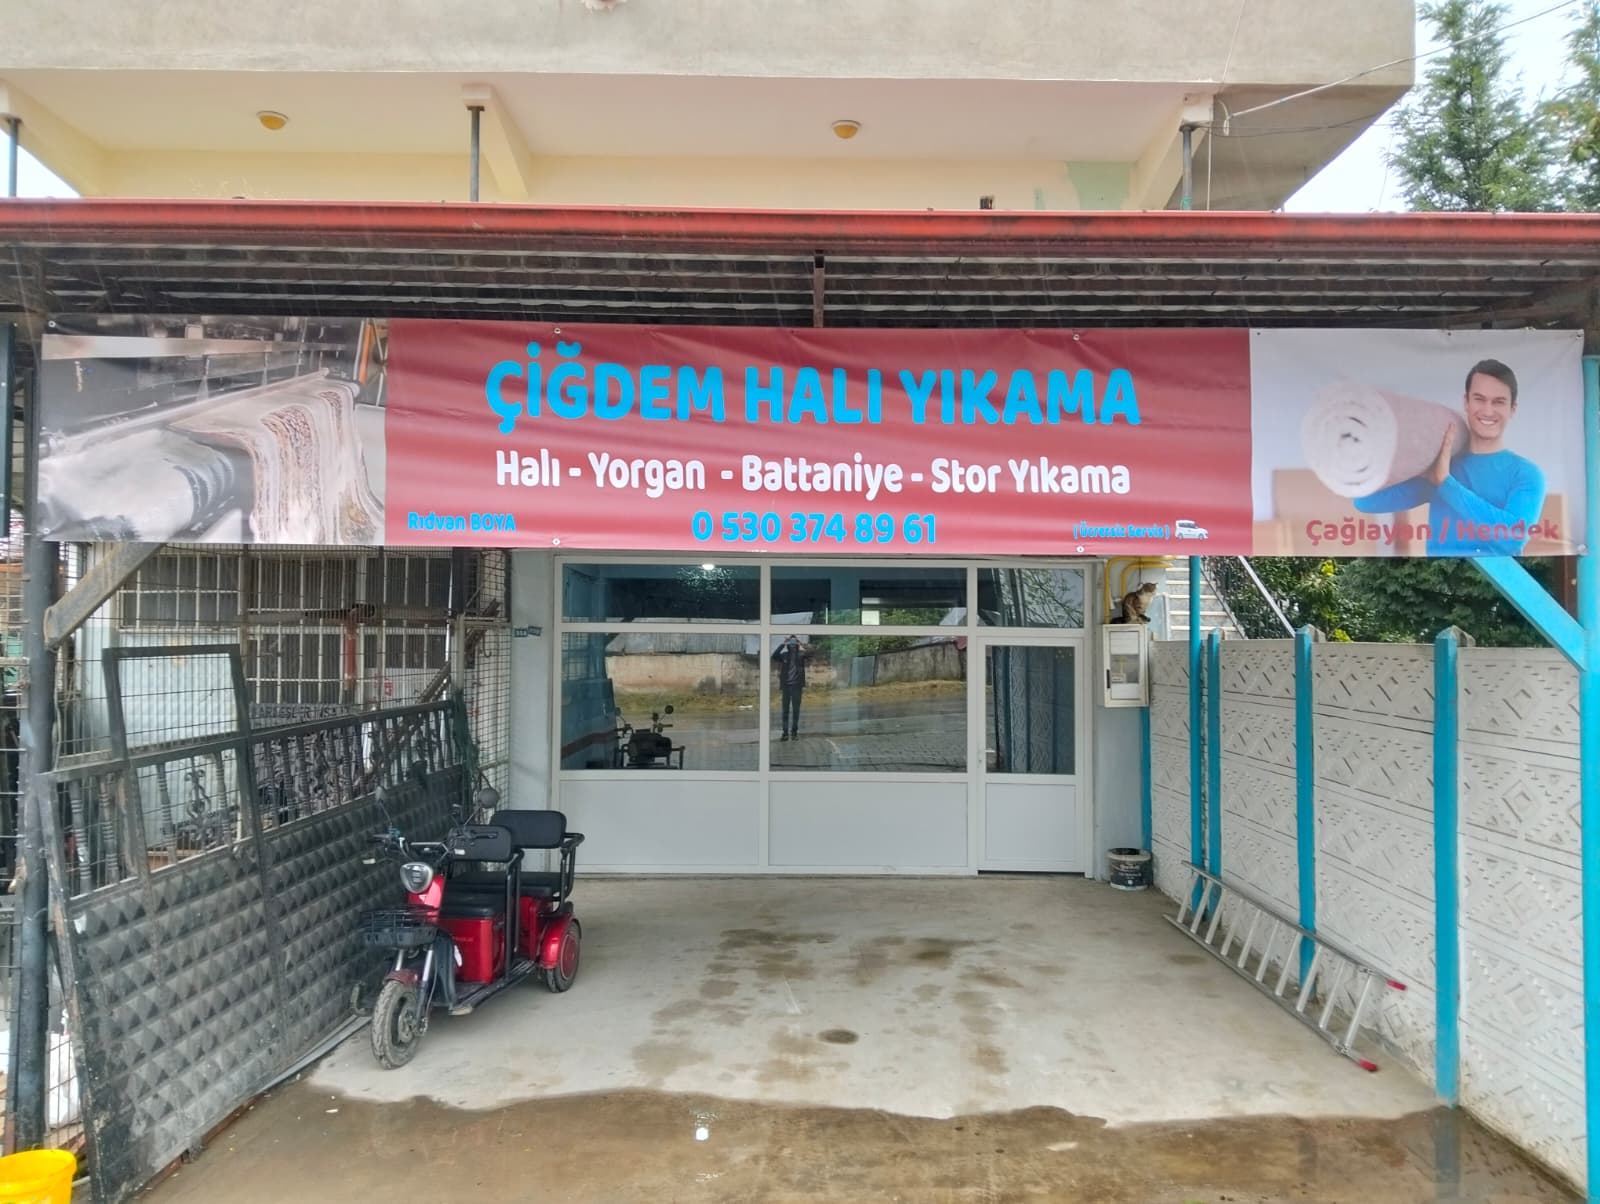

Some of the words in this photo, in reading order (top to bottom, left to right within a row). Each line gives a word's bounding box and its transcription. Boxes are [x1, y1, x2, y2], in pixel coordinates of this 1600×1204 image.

[486, 341, 726, 434] ÇİĞDEM
[744, 366, 883, 424] HALI
[898, 368, 1142, 426] YIKAMA
[496, 449, 561, 487] Halı
[568, 467, 582, 477] -
[587, 453, 706, 499] Yorgan
[720, 470, 734, 480] -
[742, 453, 904, 501] Battaniye
[910, 472, 924, 482] -
[931, 458, 1002, 493] Stor
[1007, 457, 1131, 494] Yıkama
[407, 511, 466, 532] Rıdvan
[469, 513, 517, 533] BOYA
[691, 510, 714, 542] 0
[721, 511, 783, 543] 530
[789, 511, 848, 543] 374
[853, 512, 896, 544] 89
[902, 512, 936, 545] 61
[1306, 517, 1432, 545] Çağlayan
[1439, 517, 1450, 544] /
[1456, 519, 1560, 541] Hendek
